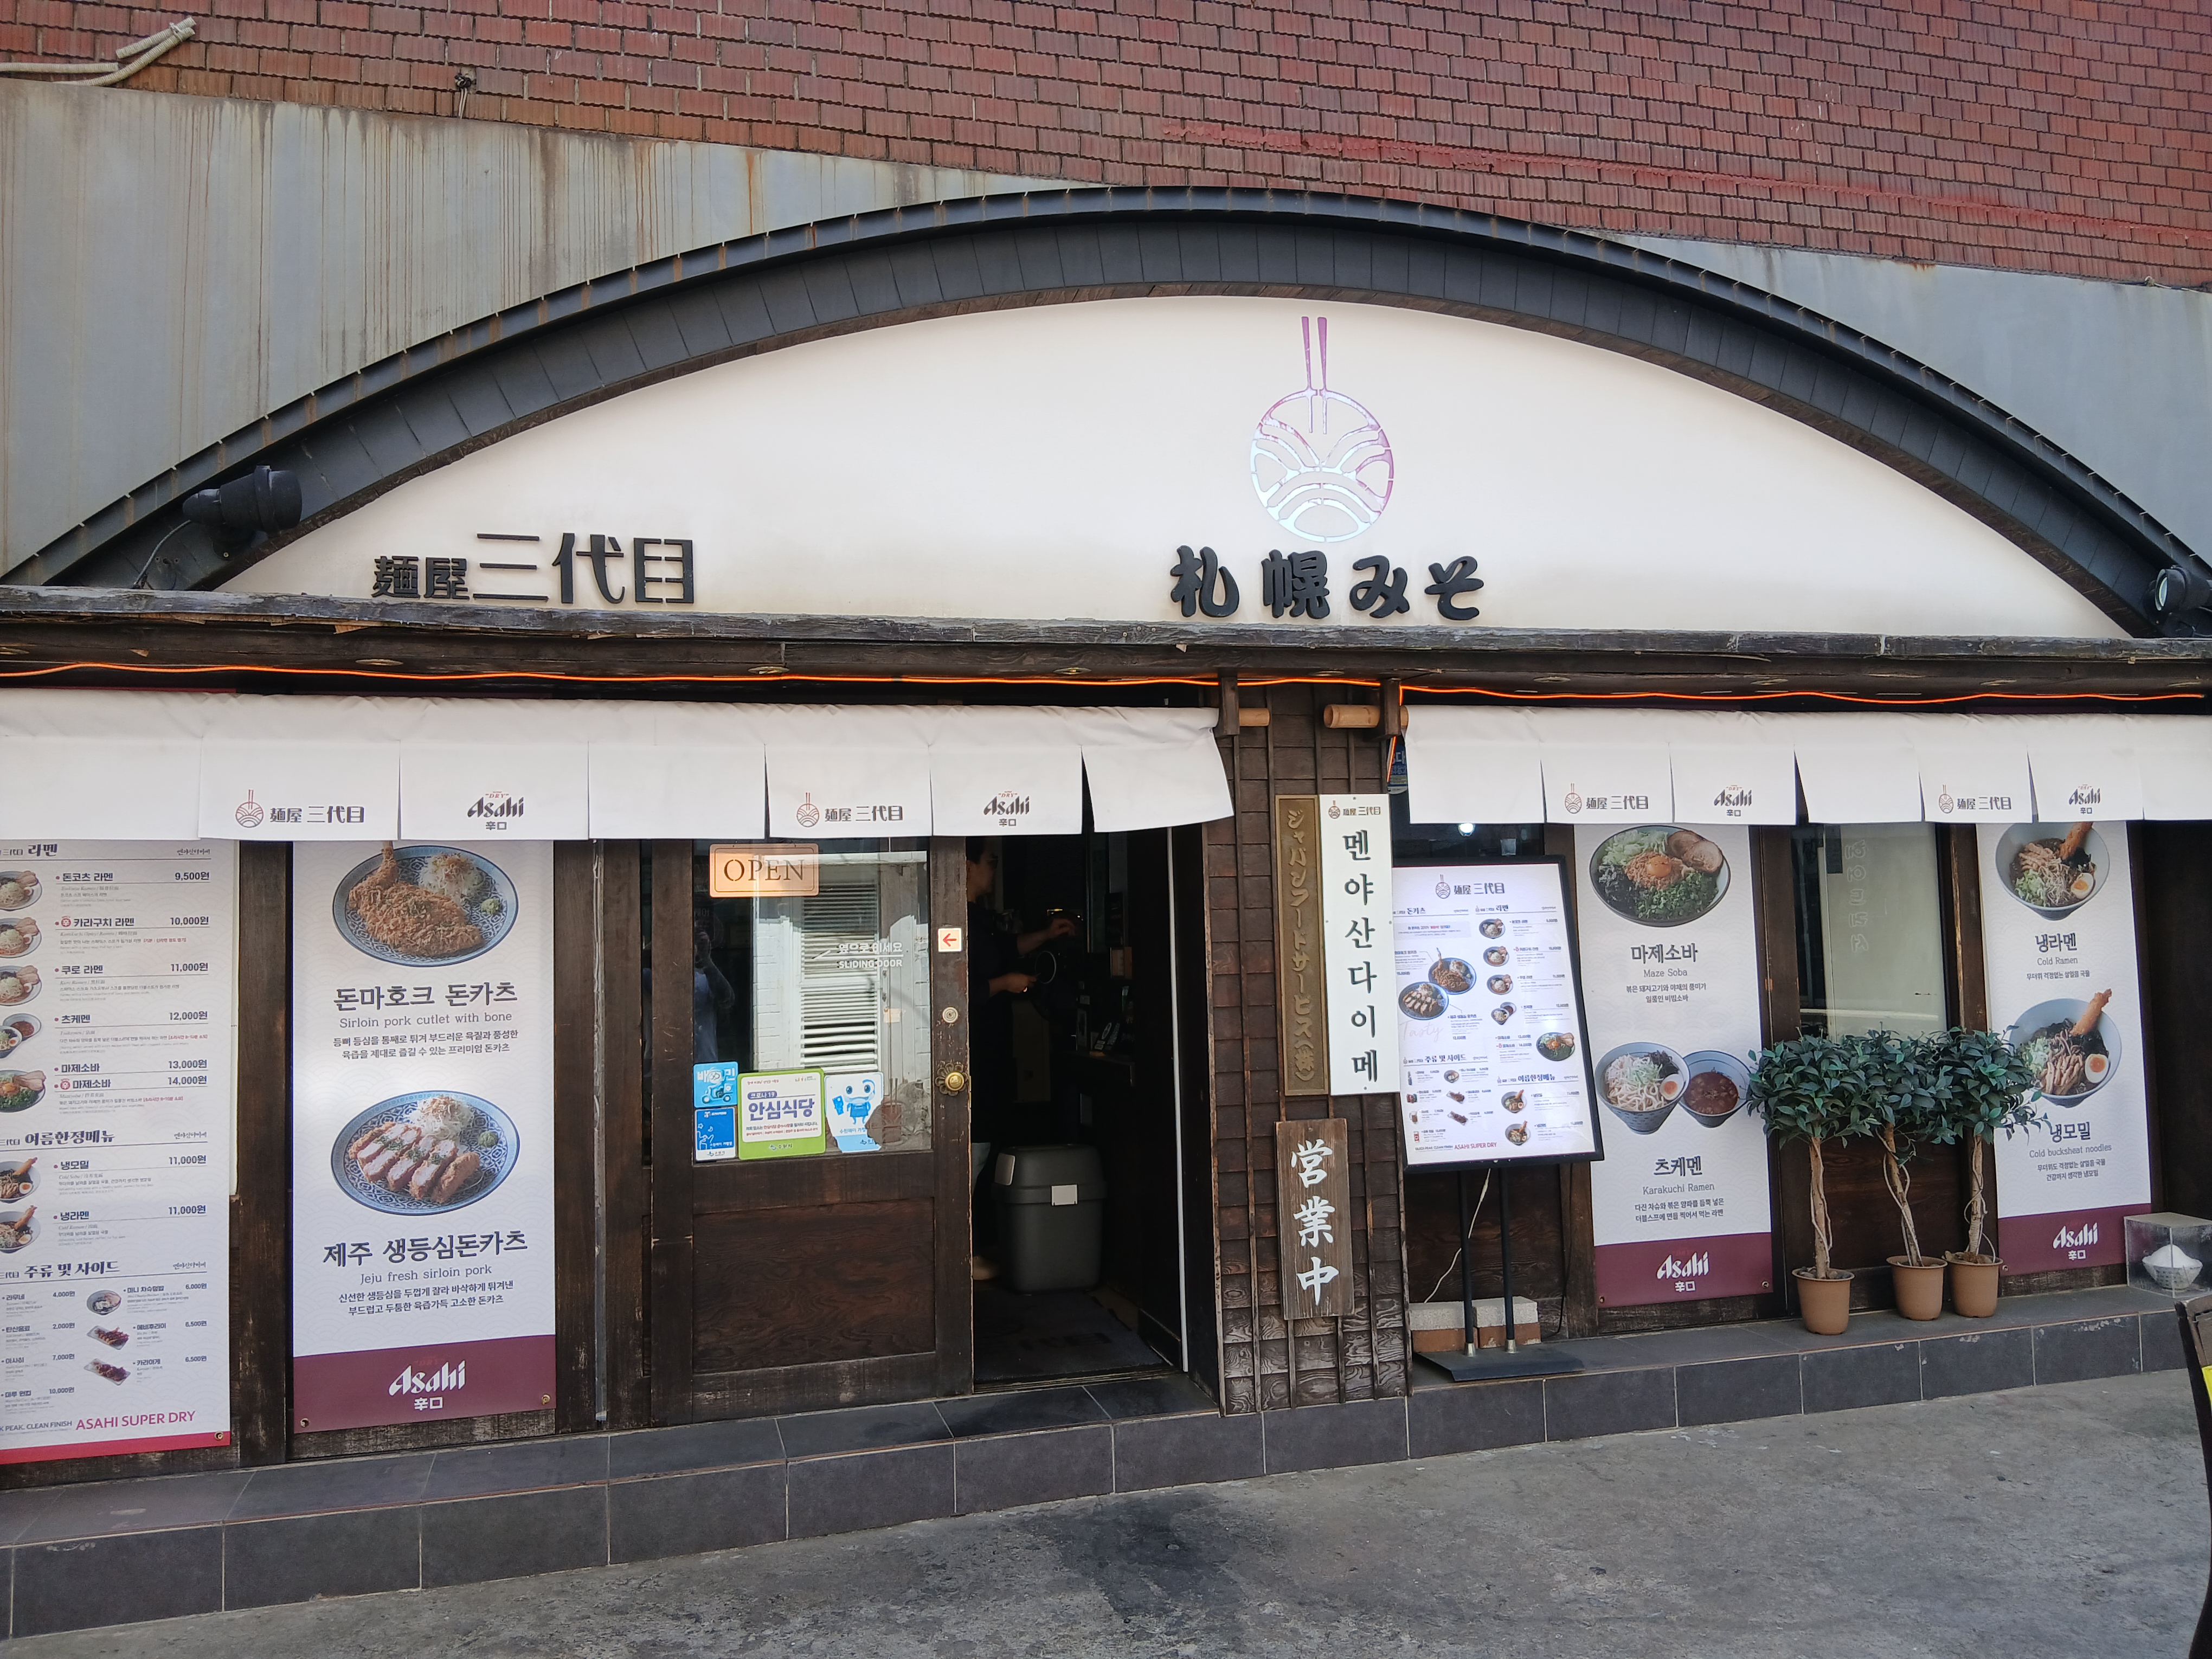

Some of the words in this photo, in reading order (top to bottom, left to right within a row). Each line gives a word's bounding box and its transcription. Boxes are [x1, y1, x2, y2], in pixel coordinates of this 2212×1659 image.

[1171, 545, 1484, 621] 札幌みそ
[1713, 789, 1752, 807] Asahi
[2068, 788, 2100, 805] Asahi
[467, 796, 524, 818] Asahi
[983, 795, 1030, 815] Asahi
[485, 821, 507, 831] 辛口
[999, 818, 1017, 827] 辛口
[28, 844, 58, 857] 라멘
[62, 873, 91, 882] 돈코츠
[94, 872, 113, 882] 라멘
[175, 872, 209, 881] 9,500원
[724, 858, 805, 882] OPEN
[74, 918, 112, 927] 카라구치
[115, 918, 134, 927] 라멘
[170, 916, 209, 926] 10,000원
[2035, 933, 2077, 953] 냉라멘
[1342, 829, 1378, 1082] 멘야산다이메
[1631, 943, 1699, 964] 마제소바
[170, 963, 208, 972] 11,000원
[877, 959, 903, 967] DOOR
[2037, 957, 2053, 966] Cold
[61, 966, 81, 974] 쿠로
[83, 965, 103, 974] 라멘
[1643, 969, 1664, 978] Maze
[1667, 968, 1687, 977] Soba
[333, 986, 435, 1011] 돈마호크
[445, 981, 518, 1007] 돈카츠
[61, 1014, 90, 1024] 츠케멘
[169, 1011, 208, 1020] 12,000원
[339, 1017, 379, 1028] Sirloin
[384, 1015, 411, 1028] pork
[416, 1014, 450, 1025] cutlet
[455, 1013, 479, 1023] with
[484, 1012, 512, 1022] bone
[1399, 1020, 1444, 1042] Tasty
[333, 1037, 351, 1047] 등뼈
[353, 1036, 380, 1046] 등심을
[382, 1034, 408, 1045] 통째로
[409, 1034, 427, 1043] 튀겨
[429, 1032, 464, 1042] 부드러운
[465, 1031, 491, 1040] 육질과
[493, 1030, 518, 1039] 풍성한
[342, 1050, 368, 1059] 육즙을
[370, 1049, 397, 1058] 제대로
[398, 1048, 416, 1057] 즐길
[418, 1047, 427, 1056] 수
[429, 1046, 446, 1055] 있는
[448, 1044, 483, 1054] 프리미엄
[484, 1043, 510, 1052] 돈카츠
[61, 1063, 100, 1072] 마제소바
[168, 1059, 207, 1069] 13,000원
[73, 1079, 111, 1089] 마제소바
[168, 1076, 207, 1085] 14,000원
[748, 1098, 815, 1121] 안심식당
[25, 1130, 115, 1146] 여름한정메뉴
[2049, 1122, 2091, 1143] 냉모밀
[2029, 1149, 2045, 1158] Cold
[2048, 1147, 2082, 1156] bucksheat
[2086, 1144, 2112, 1153] noodles
[61, 1160, 89, 1169] 냉모밀
[169, 1155, 207, 1165] 11,000원
[1654, 1155, 1702, 1176] 츠케멘
[1642, 1185, 1684, 1195] Karakuchi
[1688, 1182, 1714, 1192] Ramen
[168, 1205, 206, 1215] 11,000원
[1635, 1203, 1647, 1211] 다진
[60, 1211, 89, 1220] 냉라멘
[2053, 1222, 2098, 1249] Asahi
[323, 1242, 373, 1267] 제주
[383, 1230, 528, 1263] 생등심돈카츠
[2068, 1250, 2086, 1260] 辛口
[24, 1265, 53, 1278] 주류
[57, 1263, 72, 1277] 및
[74, 1261, 120, 1275] 사이드
[1656, 1251, 1709, 1279] Asahi
[360, 1274, 382, 1285] Jeju
[387, 1270, 419, 1281] fresh
[423, 1267, 460, 1279] sirloin
[465, 1264, 492, 1277] pork
[338, 1293, 365, 1303] 신선한
[366, 1290, 402, 1301] 생등심을
[404, 1288, 430, 1297] 두껍게
[432, 1286, 449, 1296] 잘라
[451, 1283, 486, 1294] 바삭하게
[487, 1281, 514, 1290] 튀겨낸
[1675, 1281, 1695, 1292] 辛口
[349, 1306, 383, 1316] 부드럽고
[385, 1303, 411, 1313] 두툼한
[413, 1300, 448, 1310] 육즙가득
[451, 1297, 476, 1307] 고소한
[478, 1295, 504, 1305] 돈카츠
[388, 1360, 466, 1396] Asahi
[414, 1397, 443, 1411] 辛口
[76, 1417, 118, 1431] ASAHI
[122, 1414, 165, 1427] SUPER
[169, 1411, 196, 1424] DRY
